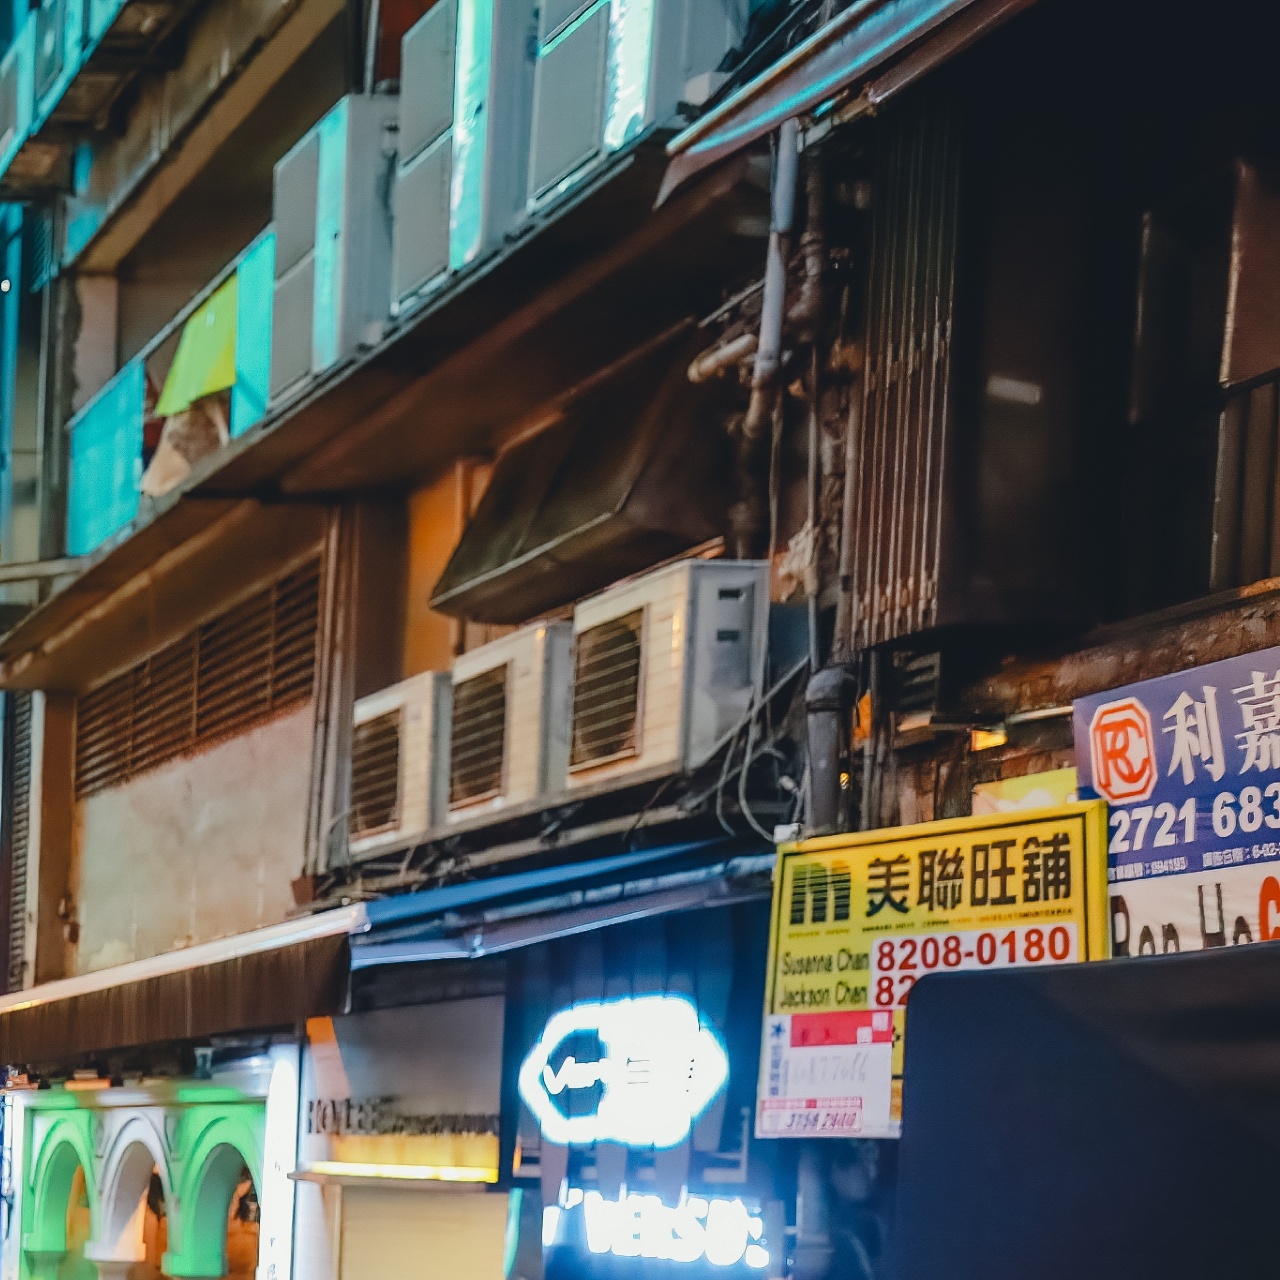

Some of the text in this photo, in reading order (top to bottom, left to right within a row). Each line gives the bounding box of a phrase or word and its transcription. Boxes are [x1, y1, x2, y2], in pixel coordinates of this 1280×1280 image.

[1108, 797, 1197, 856] 2721
[865, 831, 1071, 917] 美聯旺舖
[876, 926, 1070, 972] 8208-0180
